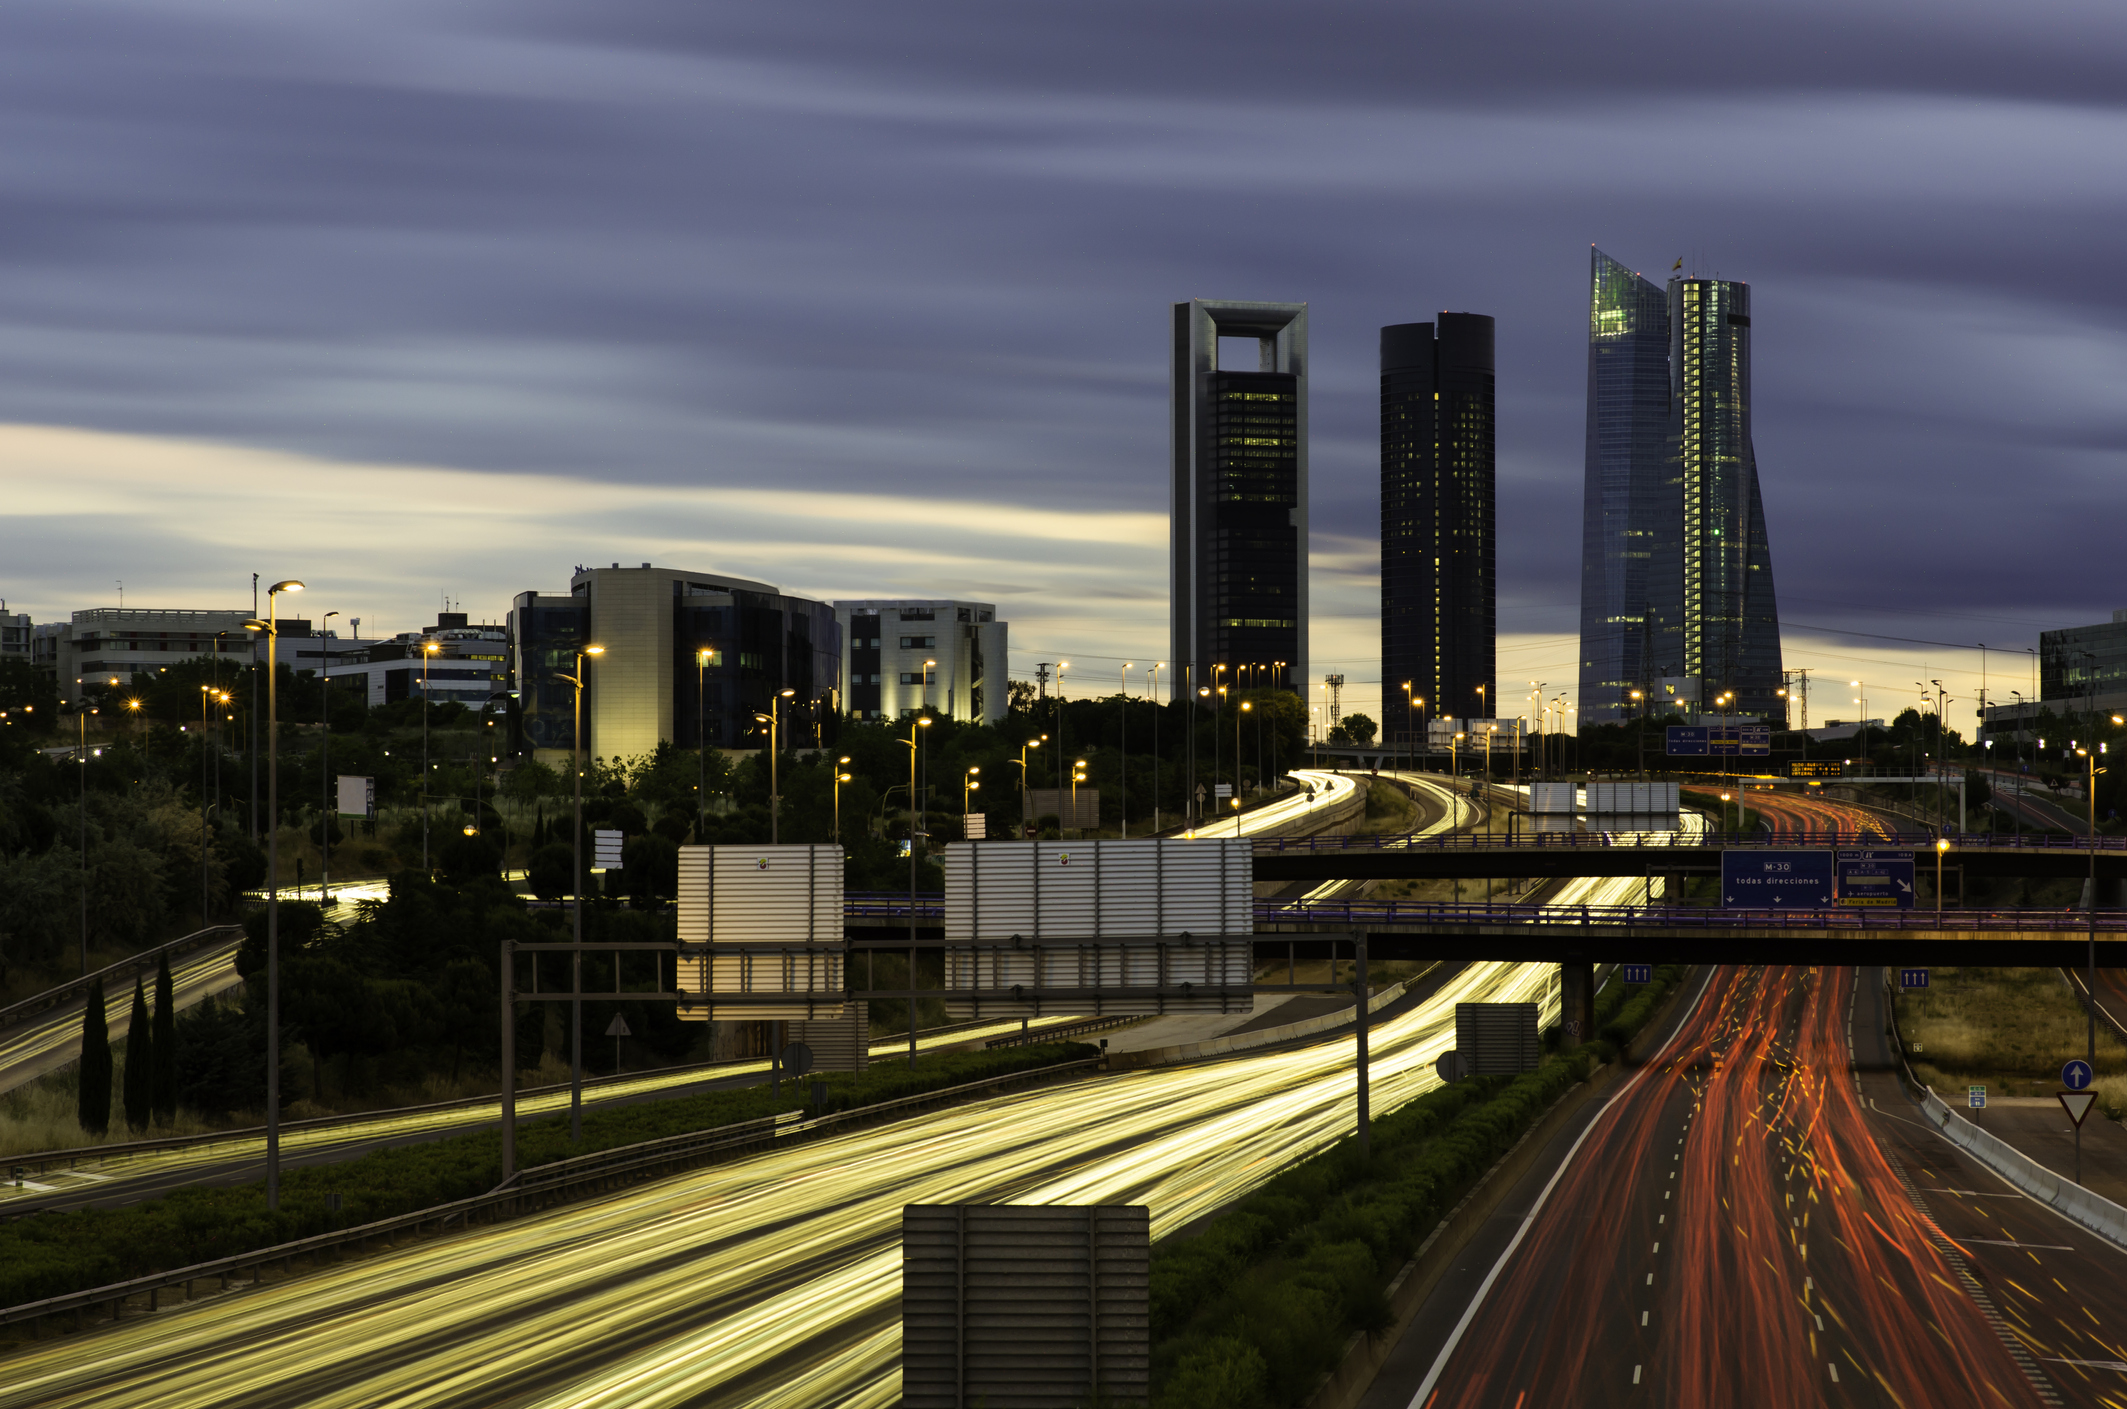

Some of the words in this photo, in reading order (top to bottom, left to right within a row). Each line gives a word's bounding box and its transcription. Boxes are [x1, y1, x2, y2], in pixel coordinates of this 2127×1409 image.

[1764, 863, 1790, 871] M-30
[1736, 877, 1762, 885] todas
[1766, 877, 1820, 885] direcciones
